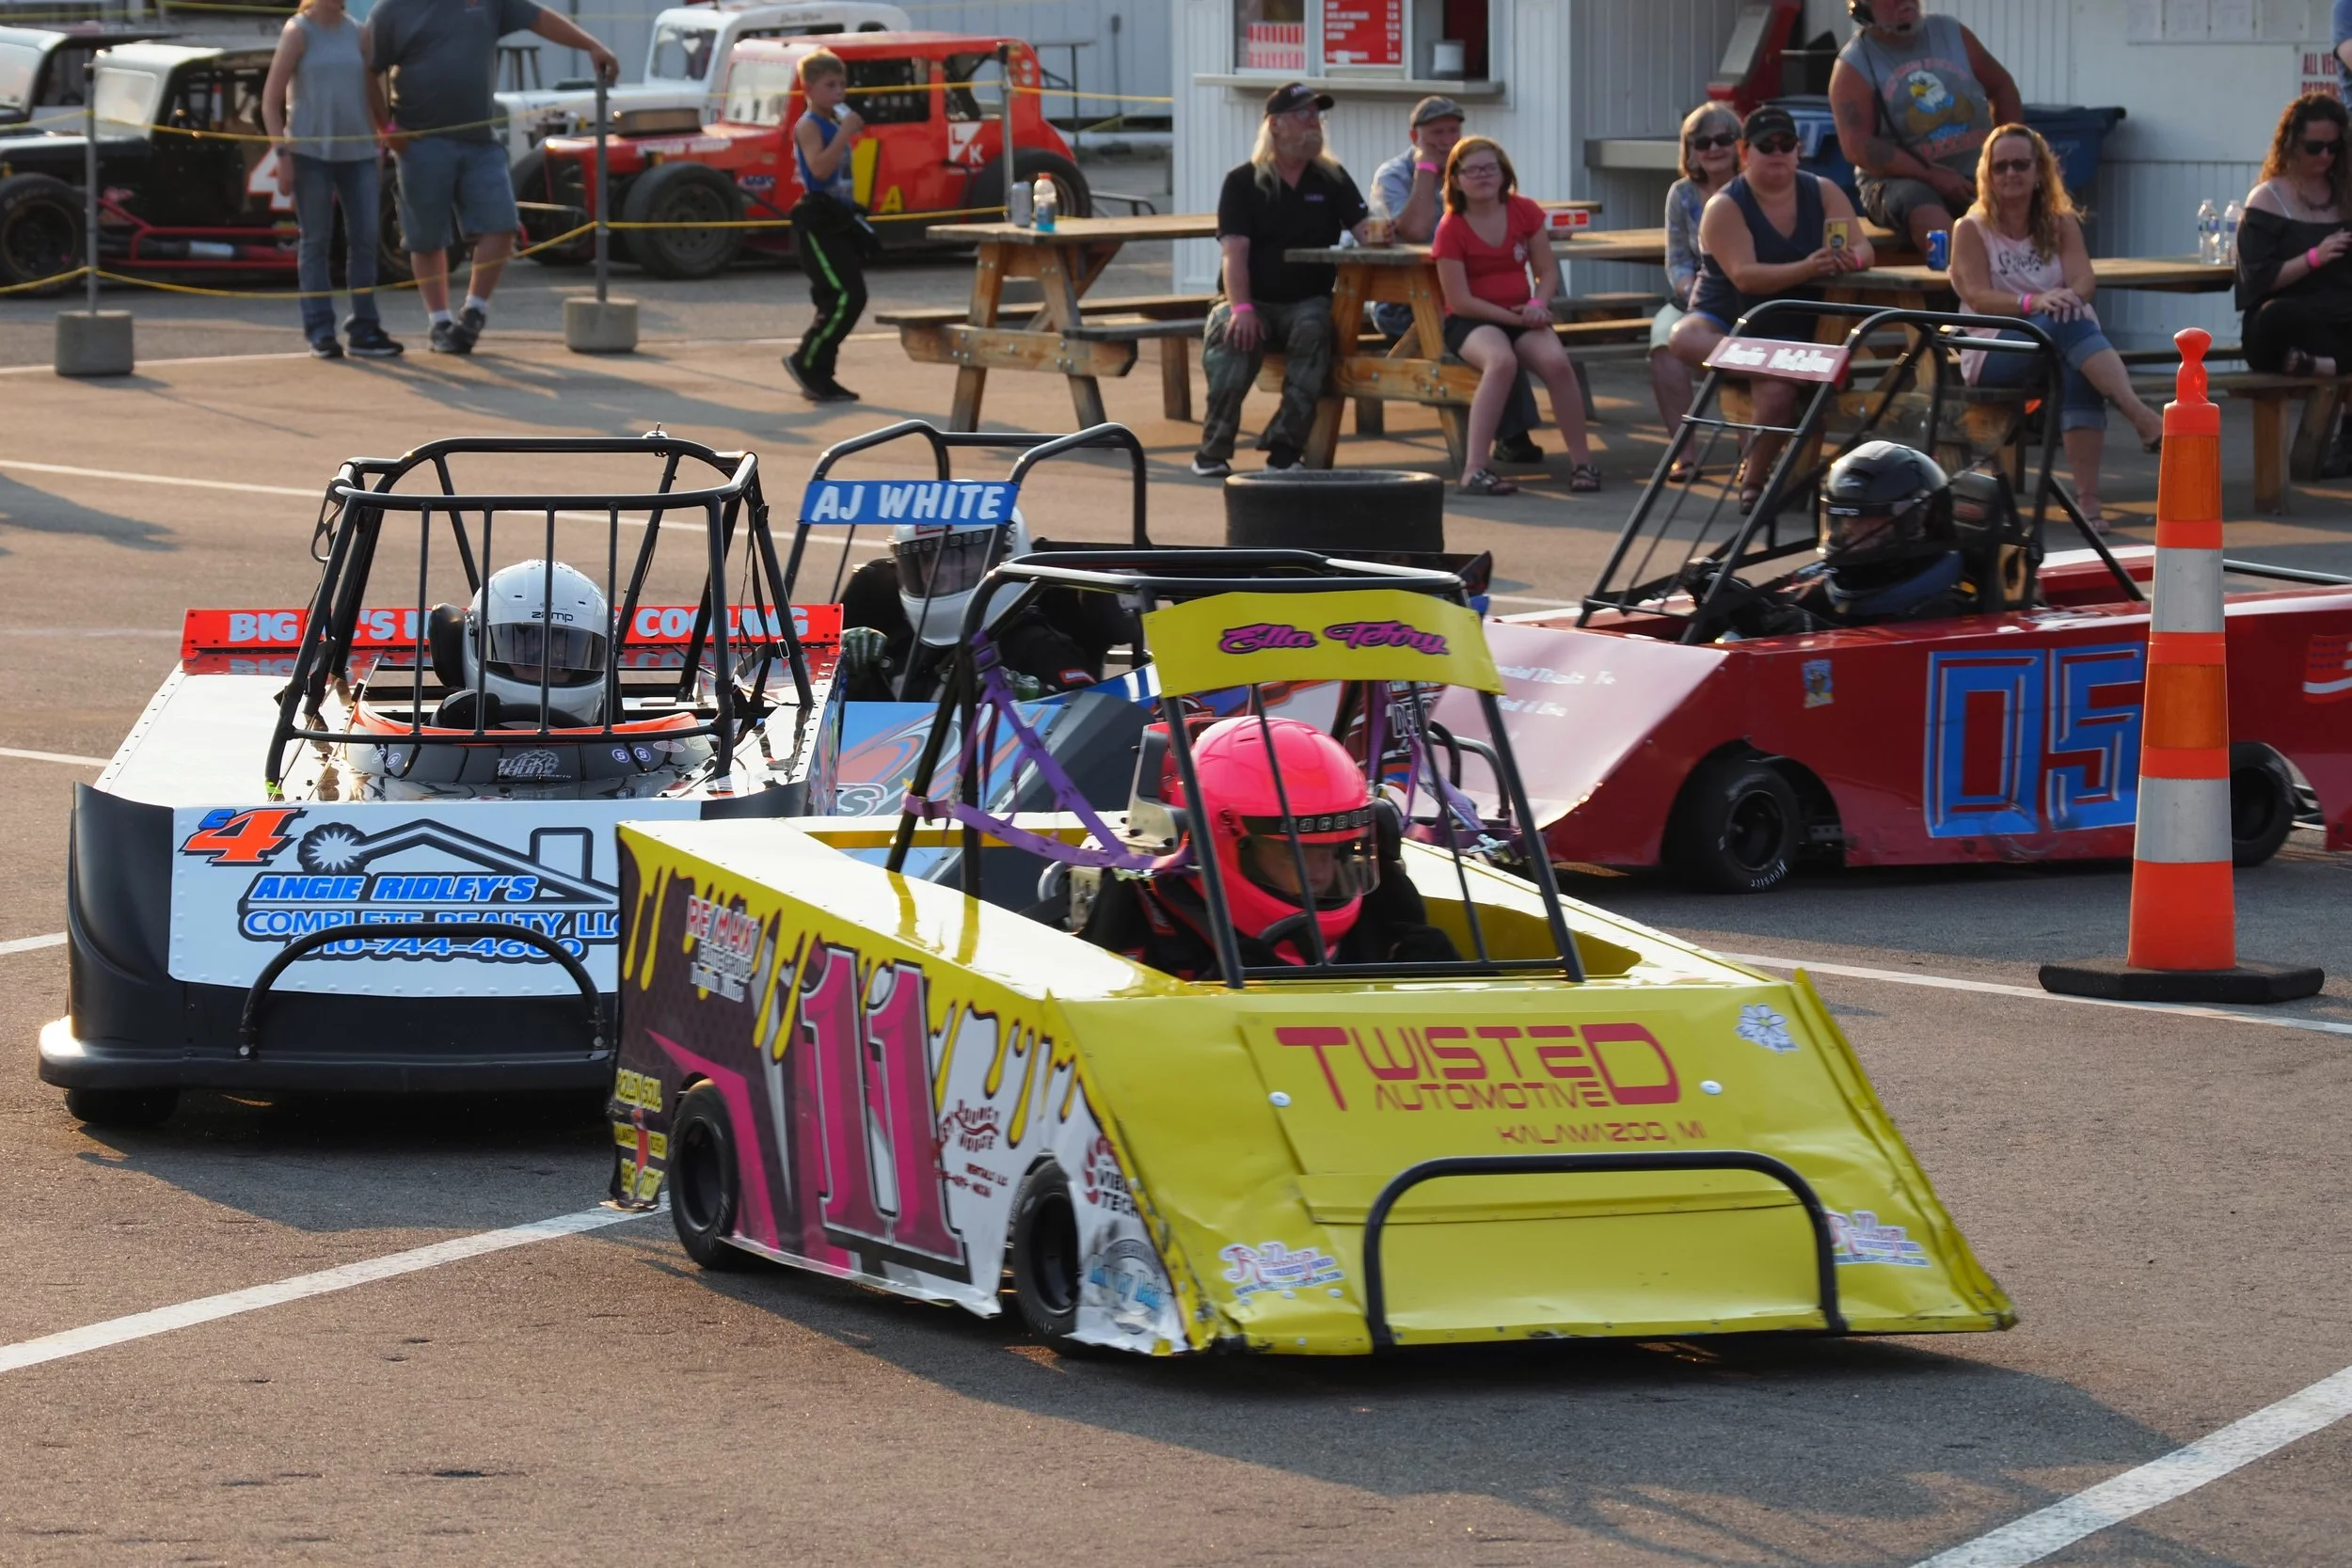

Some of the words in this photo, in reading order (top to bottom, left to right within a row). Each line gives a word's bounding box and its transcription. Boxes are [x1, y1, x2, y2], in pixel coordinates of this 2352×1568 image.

[810, 485, 866, 522] AJ
[878, 483, 1006, 520] WHITE
[228, 611, 298, 642] BIG
[1218, 622, 1319, 655] Ella
[1923, 641, 2146, 838] 05
[247, 875, 367, 901] ANGIE
[370, 875, 539, 902] RIDLEY'S
[686, 894, 759, 958] RE/MAX
[292, 935, 583, 958] 10-744-460
[1274, 1022, 1681, 1113] TWISTED
[799, 942, 967, 1270] 11
[1375, 1080, 1611, 1112] AUTOMOTIVE
